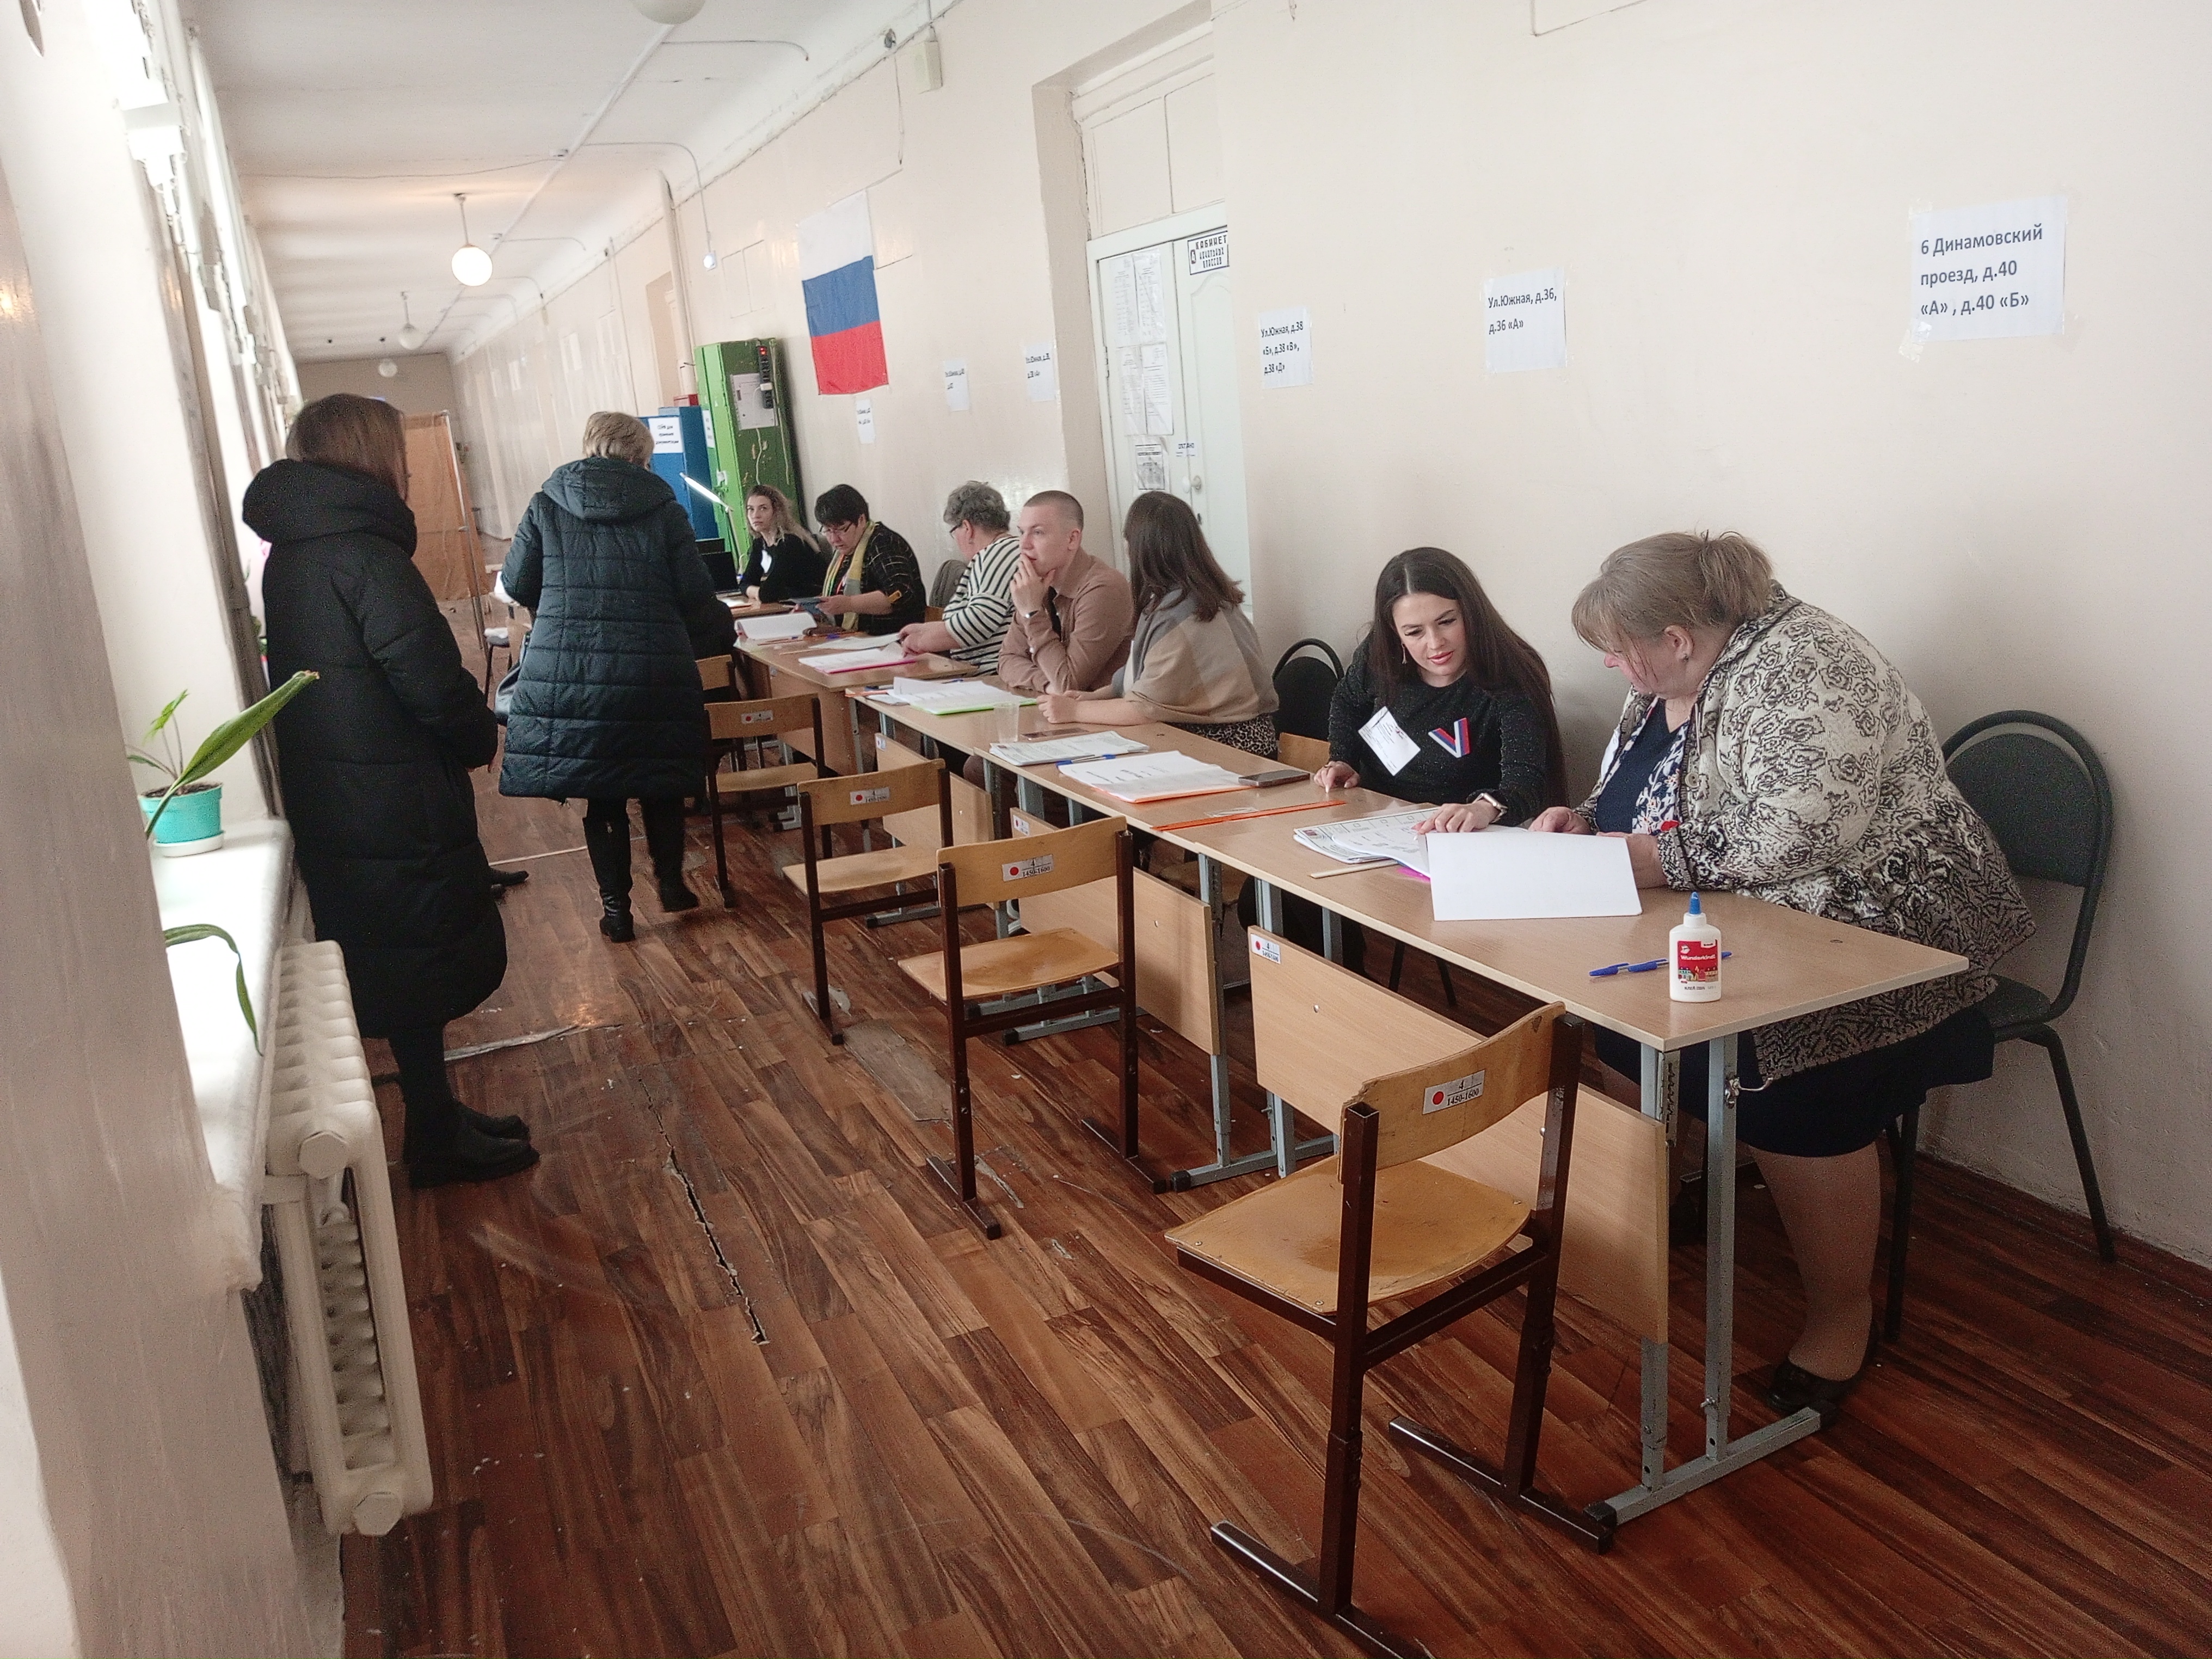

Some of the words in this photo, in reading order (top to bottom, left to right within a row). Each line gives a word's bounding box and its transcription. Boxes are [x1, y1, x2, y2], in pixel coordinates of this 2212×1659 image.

[1921, 239, 1929, 255] 6
[1932, 223, 2043, 257] Динамовский
[1920, 268, 1978, 288] проезд,
[1982, 260, 2018, 282] д.40
[1488, 293, 1533, 309] Ул.Южная,
[1535, 287, 1557, 304] д.36,
[1920, 300, 1948, 316] «А»
[1960, 294, 1994, 316] д.40
[2000, 292, 2029, 308] «Б»
[1489, 319, 1506, 335] д.36
[1508, 318, 1523, 330] «А»
[1459, 1080, 1464, 1090] 4
[1446, 1087, 1480, 1106] 1450-1600
